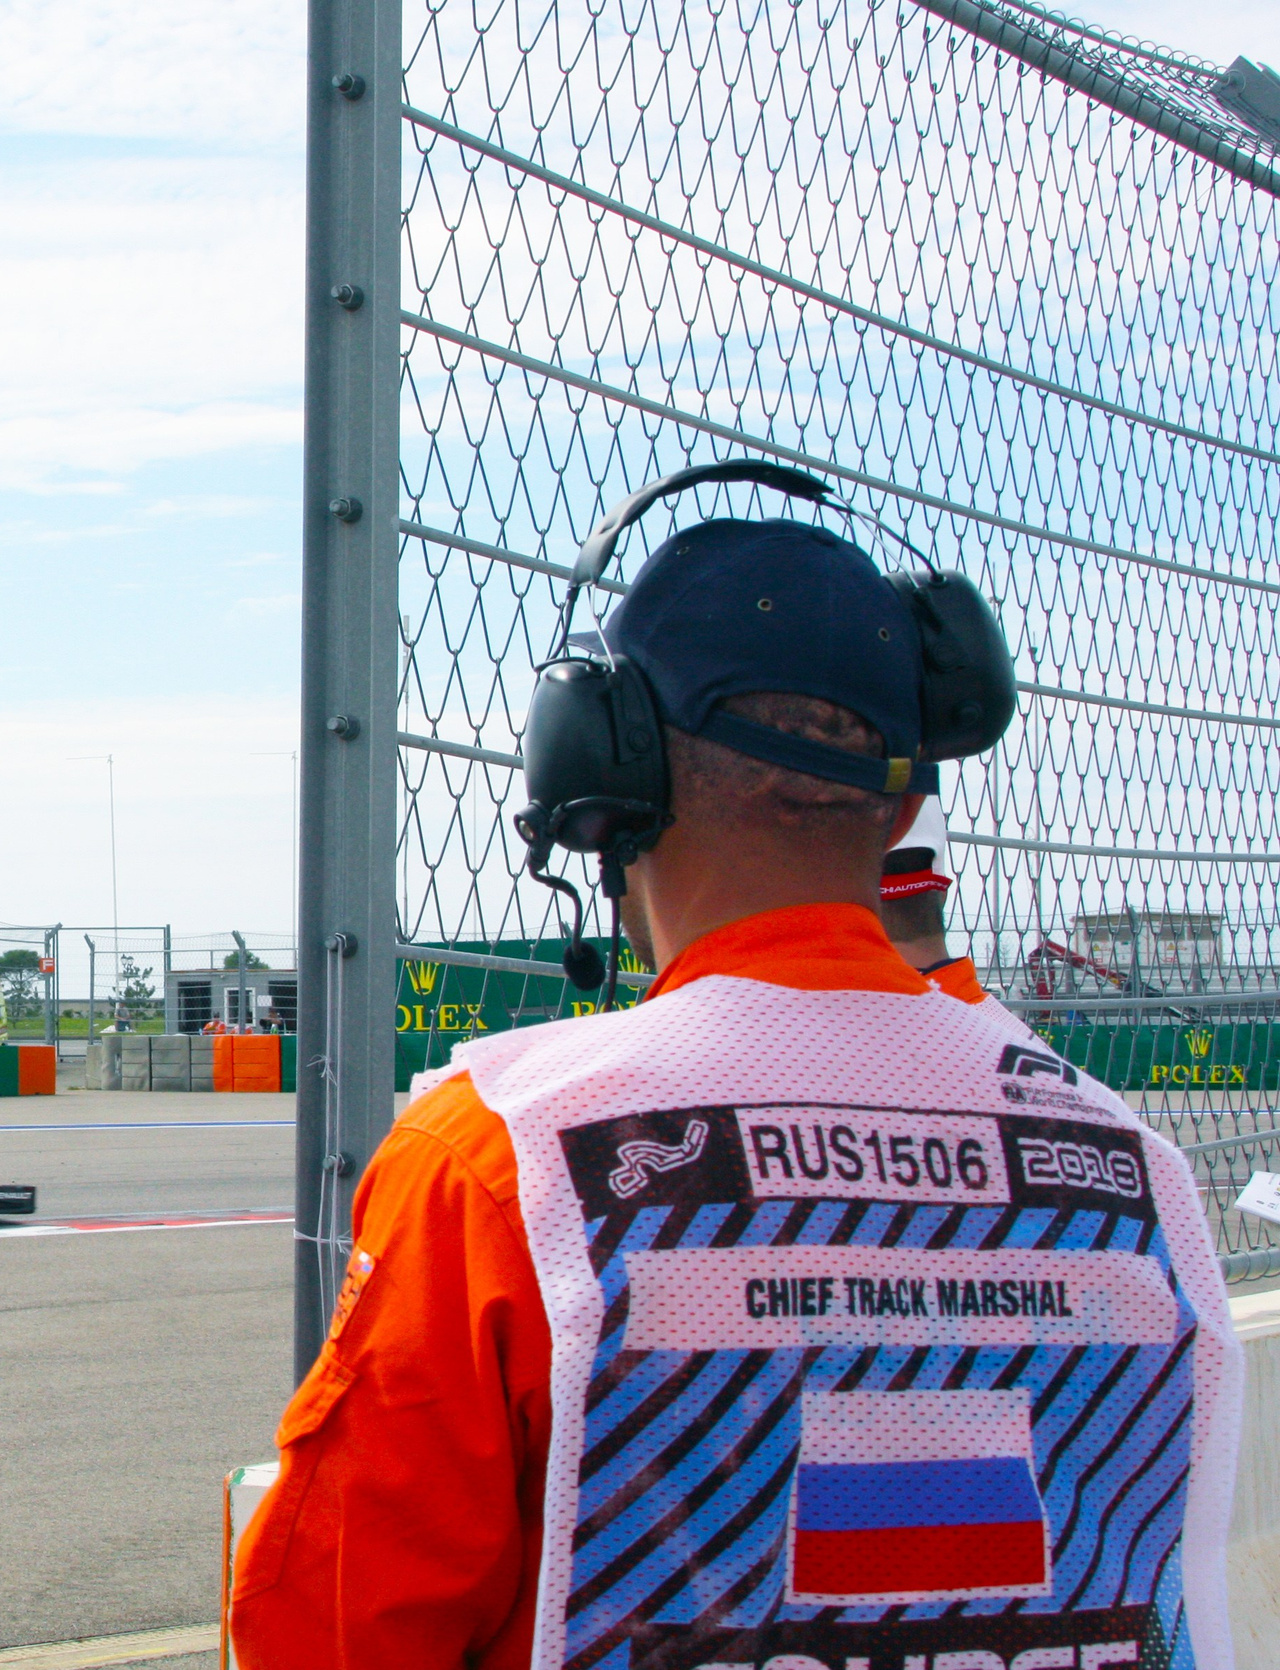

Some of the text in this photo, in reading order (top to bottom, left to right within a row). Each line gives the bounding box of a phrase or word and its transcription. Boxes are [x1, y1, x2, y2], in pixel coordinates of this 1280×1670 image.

[42, 959, 54, 971] F
[395, 1003, 489, 1032] OLEX
[1150, 1064, 1249, 1085] ROLEX
[749, 1125, 988, 1191] RUS1506
[1017, 1137, 1143, 1199] 2018
[745, 1277, 1073, 1319] CHIEF TRACK MARSHAL
